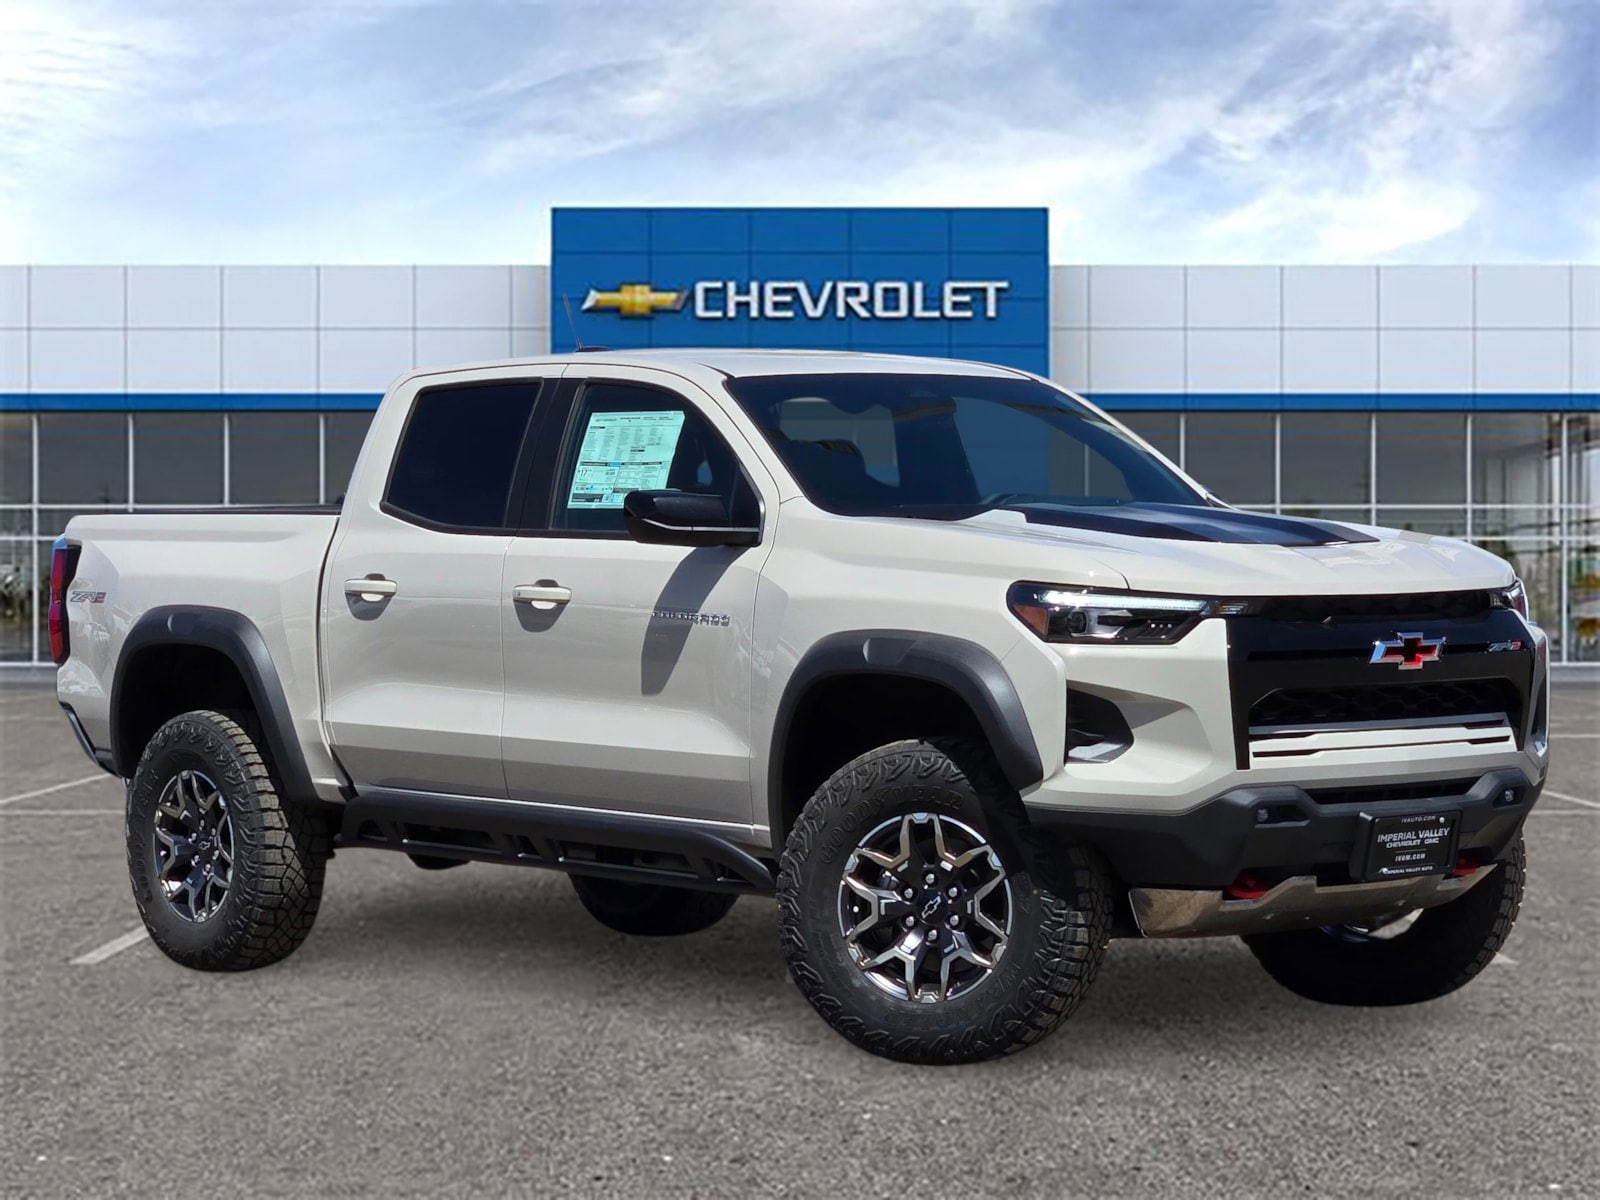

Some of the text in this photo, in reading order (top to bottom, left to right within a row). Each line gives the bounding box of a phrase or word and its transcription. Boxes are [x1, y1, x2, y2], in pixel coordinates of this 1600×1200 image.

[694, 280, 1009, 319] CHEVROLET
[70, 591, 107, 604] ZR2
[1377, 828, 1450, 843] IMPERIAL VALLEY
[1386, 837, 1440, 849] CHEVROLET GMC
